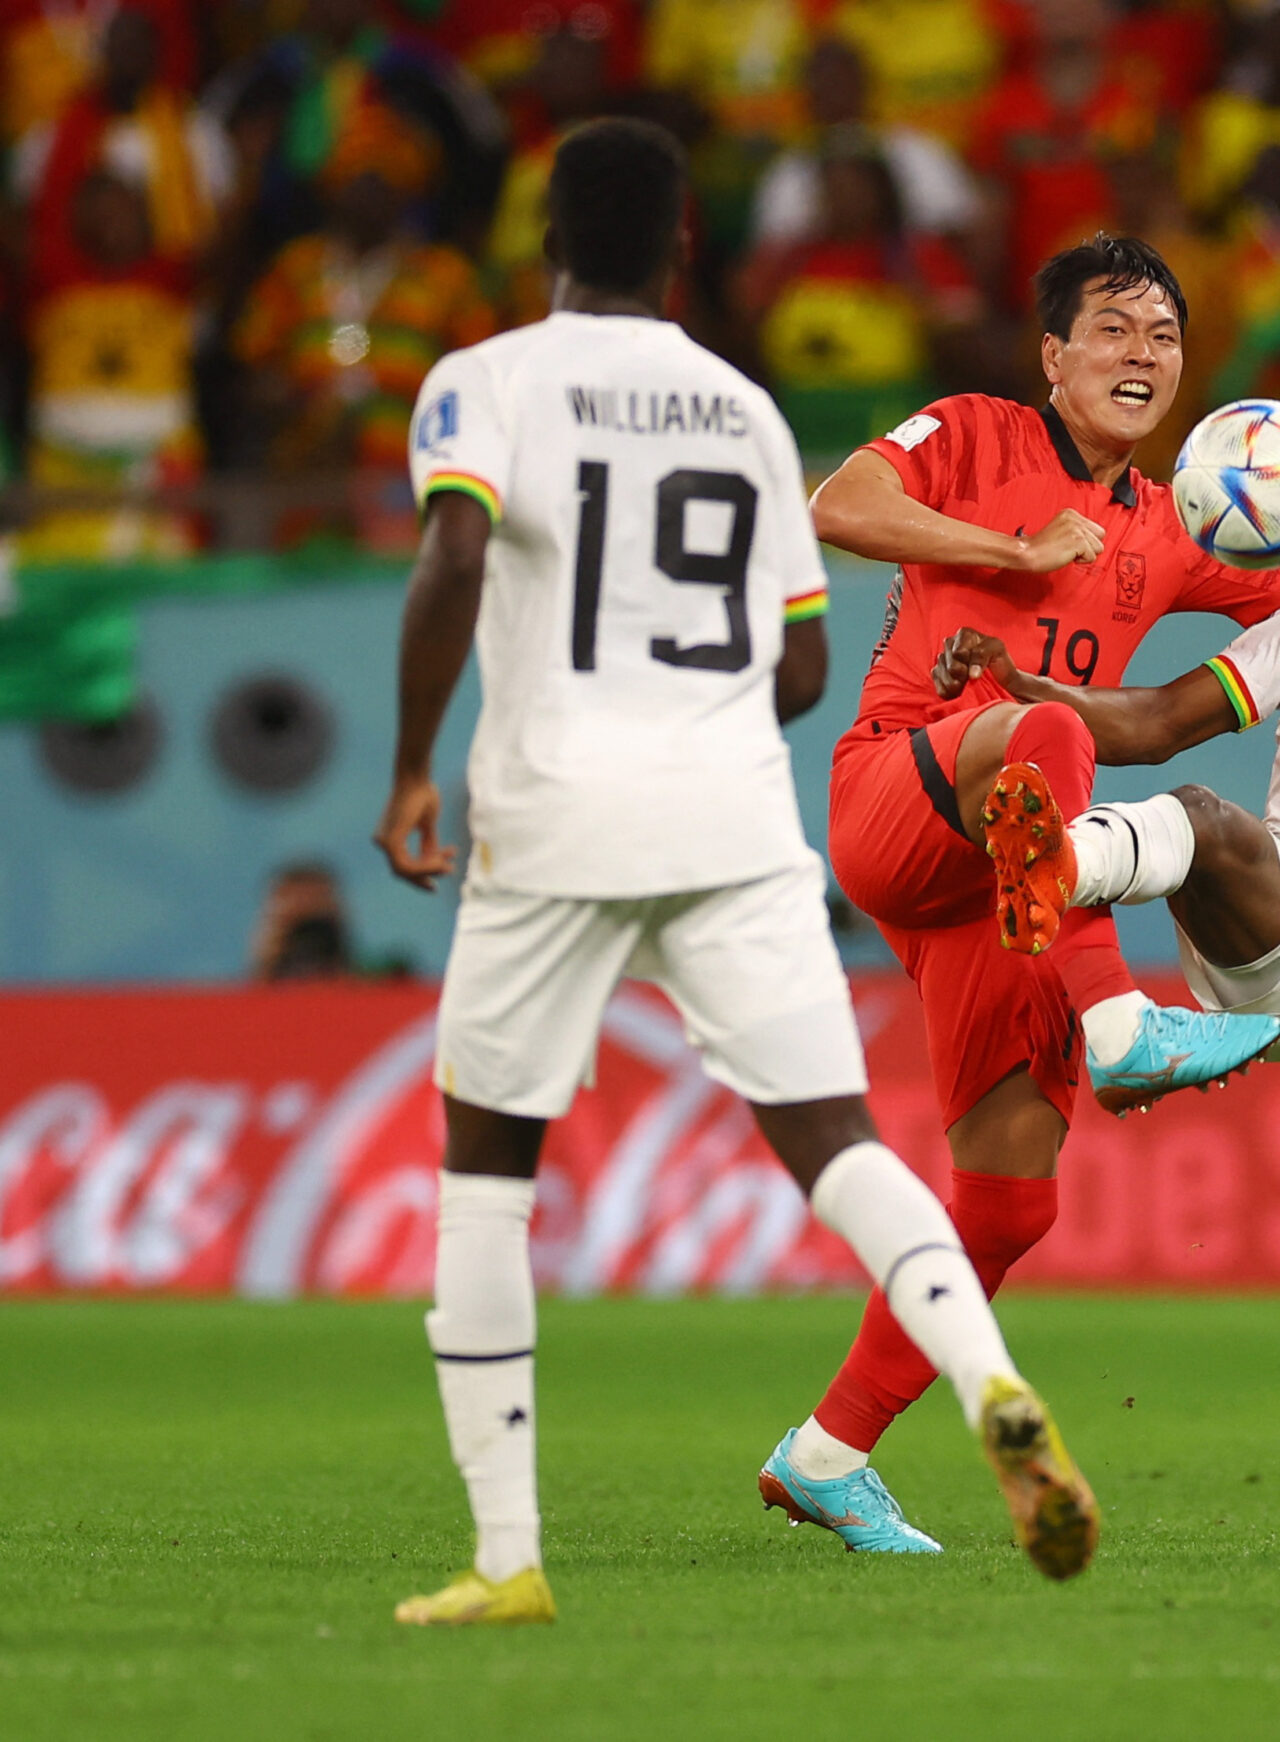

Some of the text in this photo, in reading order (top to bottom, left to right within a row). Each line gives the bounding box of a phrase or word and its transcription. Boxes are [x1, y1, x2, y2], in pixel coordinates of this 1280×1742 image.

[566, 385, 748, 438] WILLIAMS
[570, 460, 758, 674] 19
[1036, 617, 1099, 686] 19
